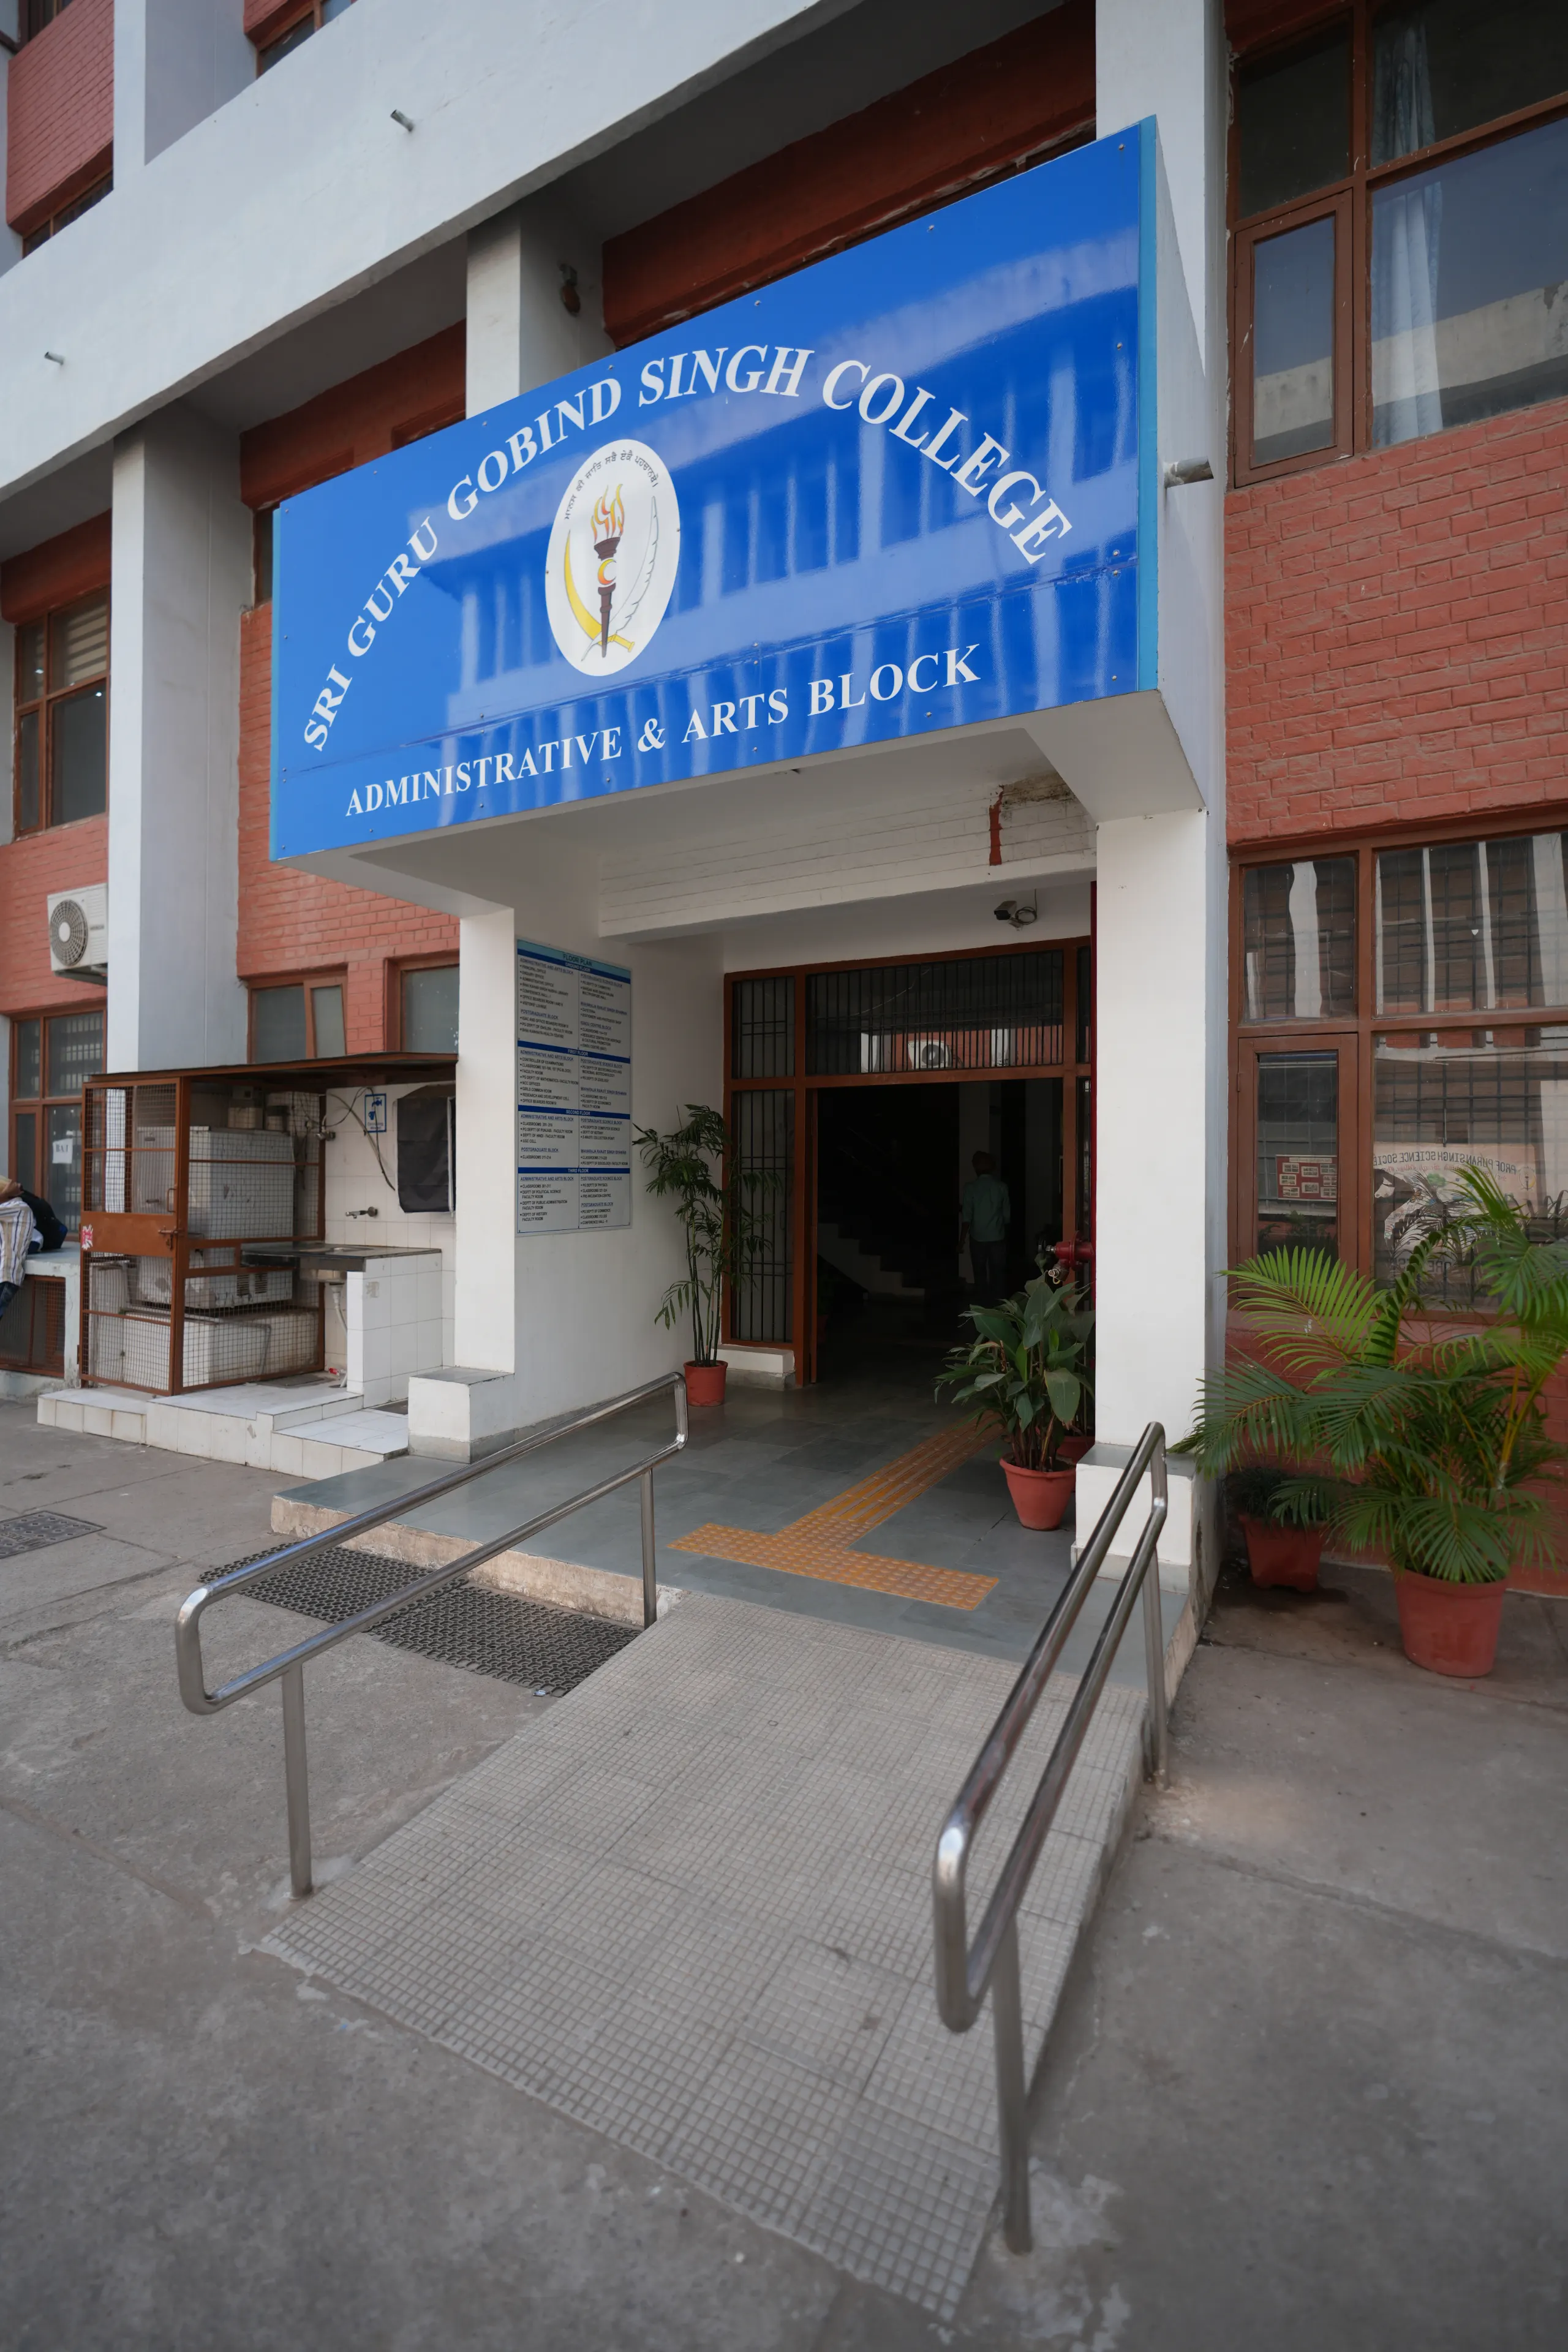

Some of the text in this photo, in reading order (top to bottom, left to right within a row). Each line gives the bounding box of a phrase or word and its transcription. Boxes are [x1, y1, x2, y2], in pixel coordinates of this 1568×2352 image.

[565, 494, 577, 520] ਮਾਨਸ
[576, 480, 585, 492] ਕੀ
[586, 461, 602, 479] ਜਾਤਿ
[304, 345, 1073, 752] SRI GURU GOBIND SINGH COLLEGE
[345, 644, 981, 817] ADMINISTRATIVE & ARTS BLOCK
[563, 954, 592, 966] FLOOR PLAN
[521, 1009, 547, 1018] POSTGRADUATE
